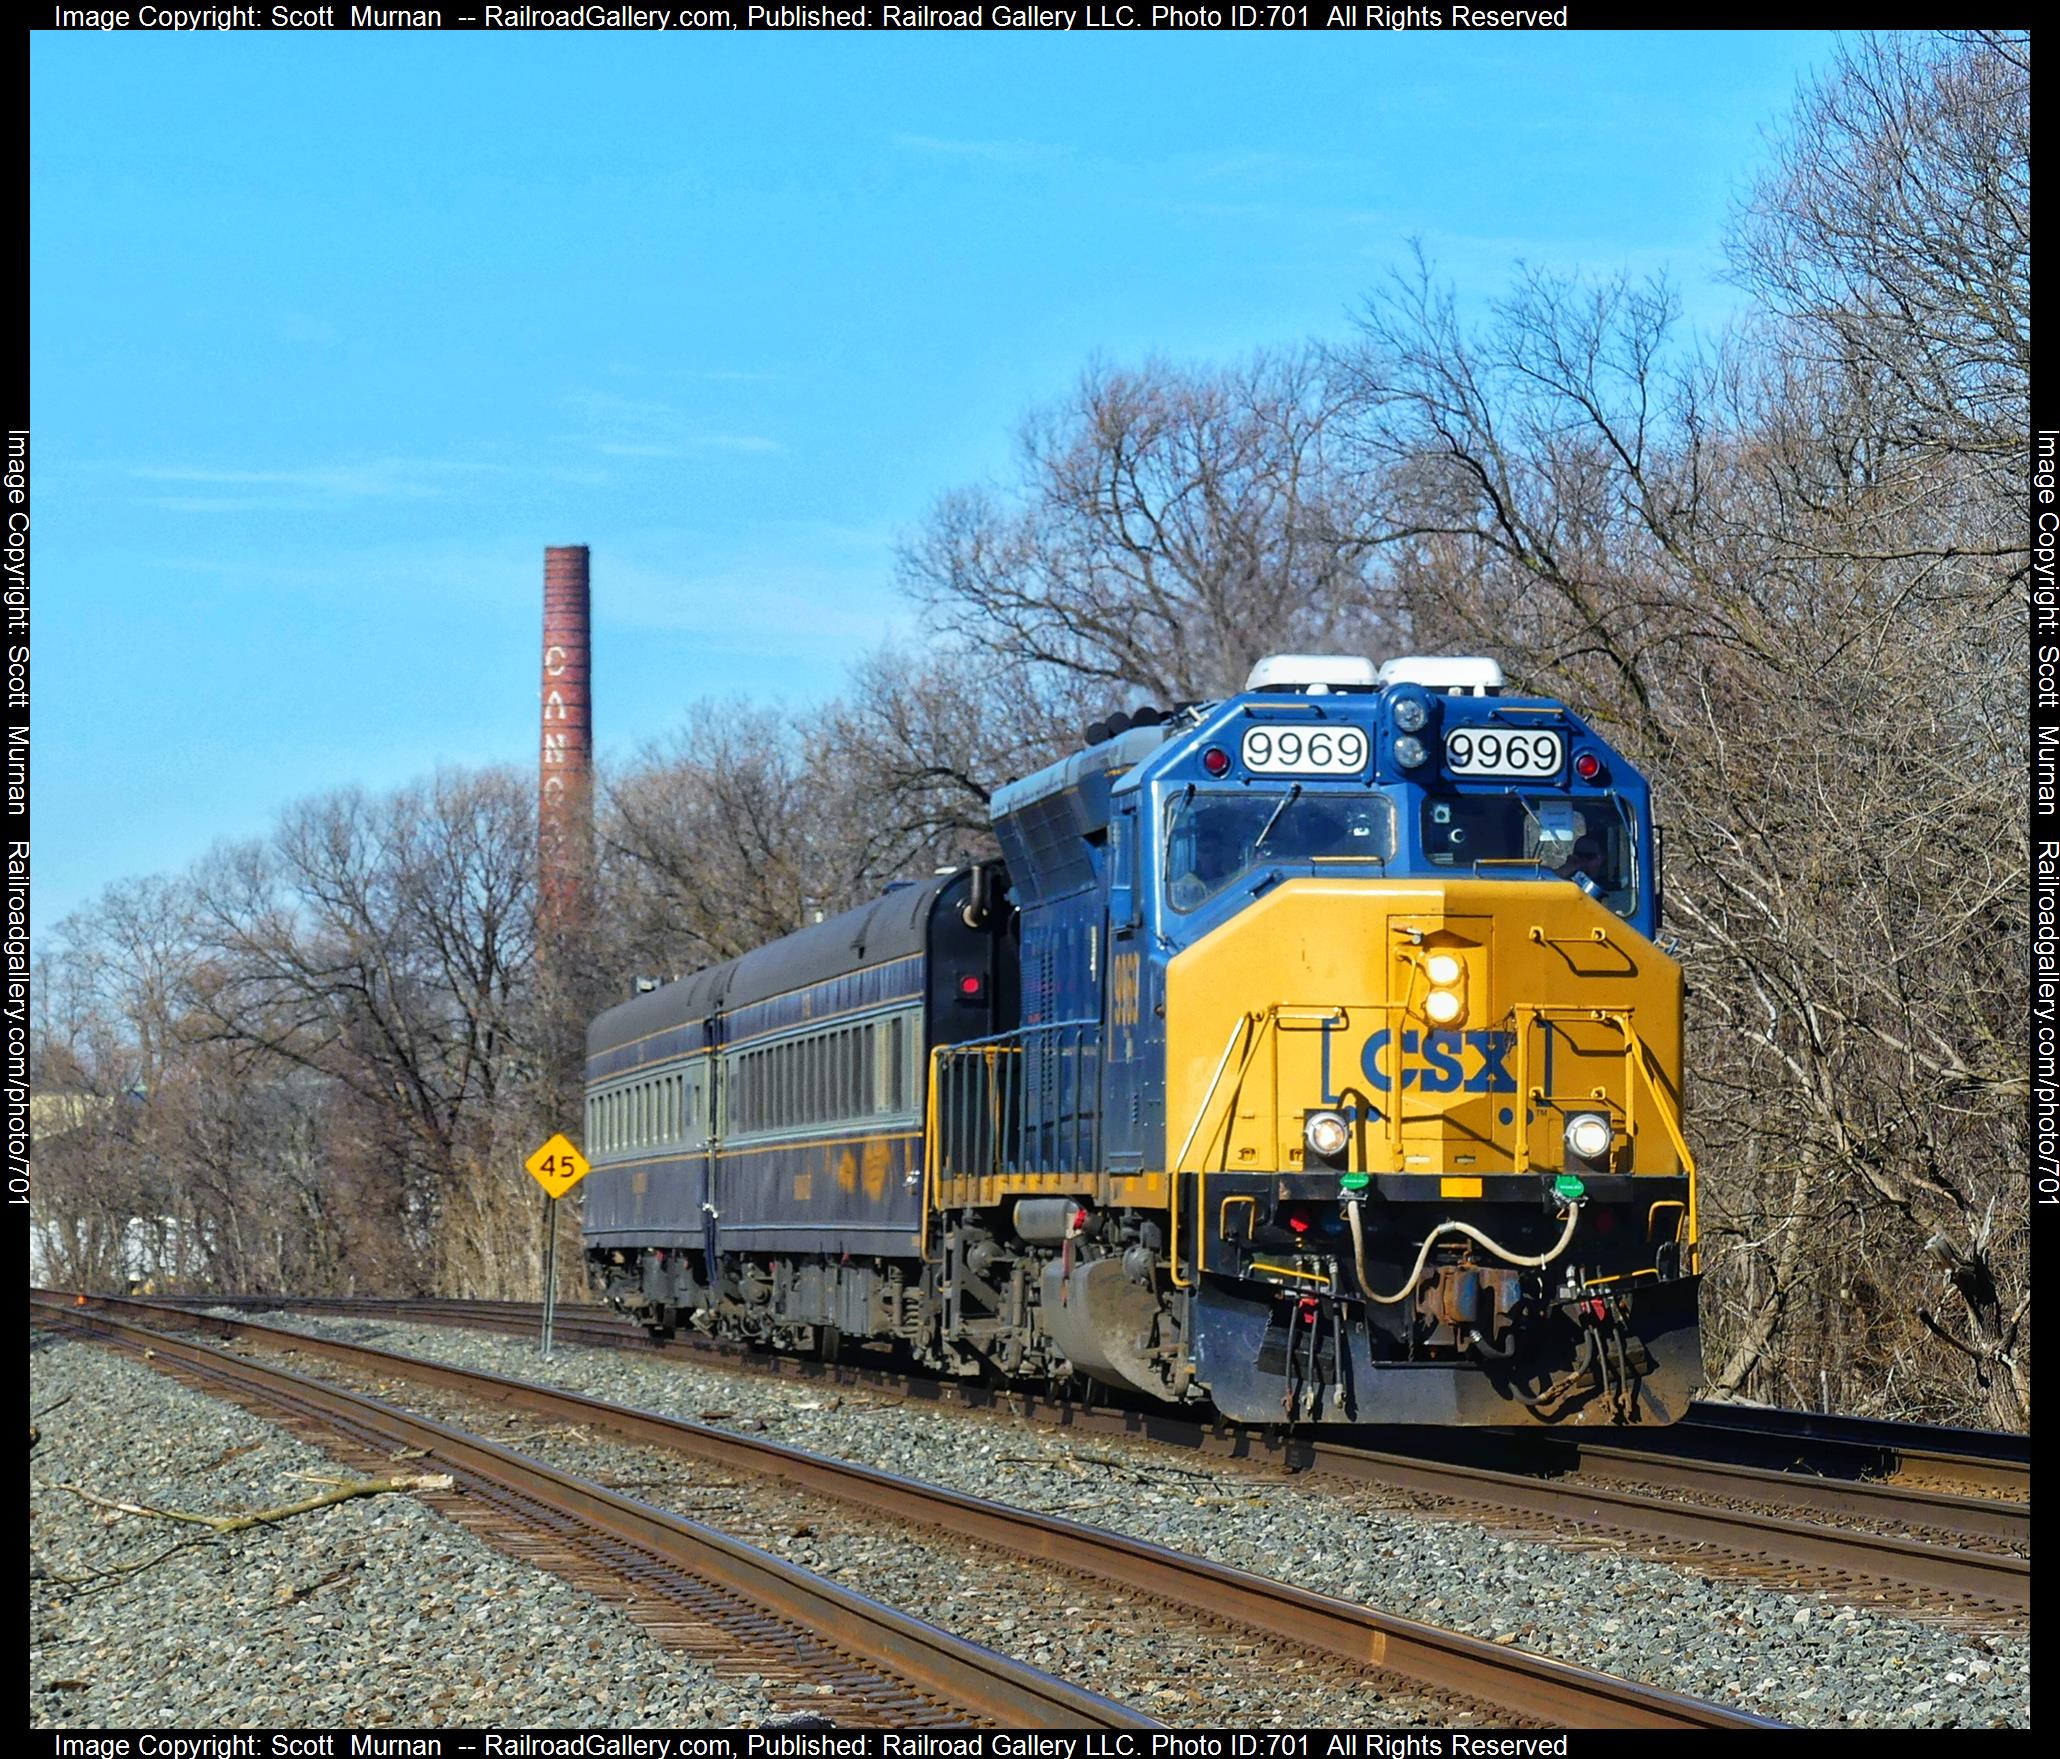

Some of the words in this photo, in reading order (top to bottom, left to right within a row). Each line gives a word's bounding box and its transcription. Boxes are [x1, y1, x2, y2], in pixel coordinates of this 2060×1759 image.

[1247, 732, 1362, 766] 9969
[1449, 734, 1557, 770] 9969
[1361, 1028, 1517, 1093] CSX
[540, 1155, 575, 1177] 45
